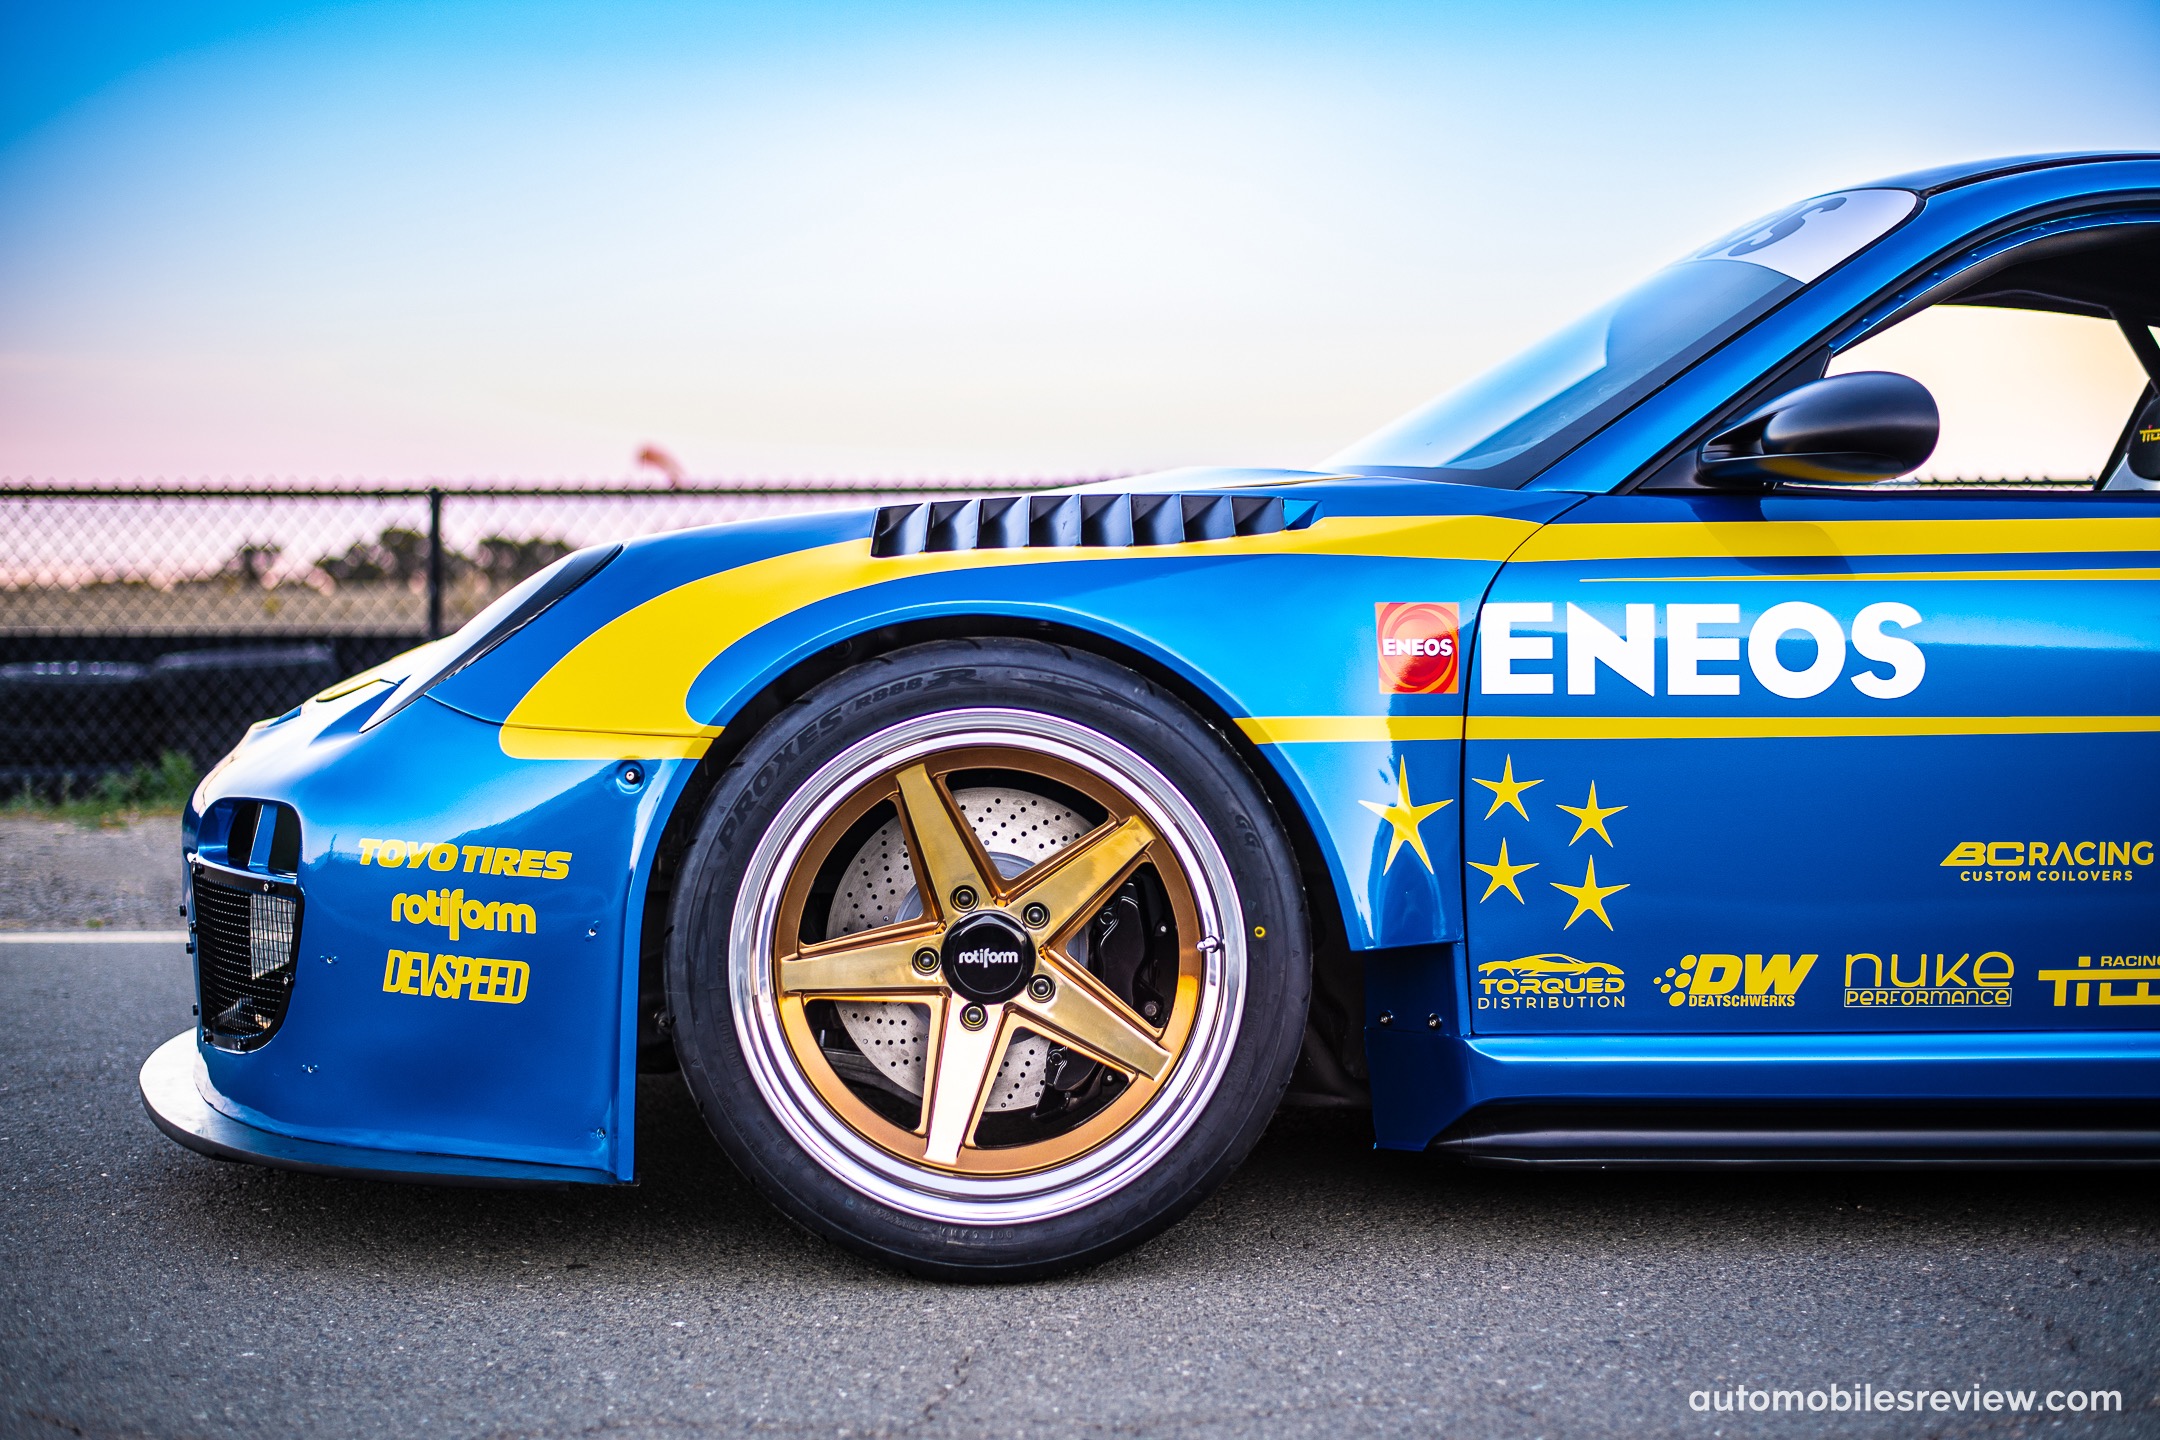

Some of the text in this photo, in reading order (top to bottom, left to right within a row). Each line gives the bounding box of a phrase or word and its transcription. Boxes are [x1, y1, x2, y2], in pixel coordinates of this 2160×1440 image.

[1382, 638, 1453, 657] ENEOS
[1480, 601, 1926, 699] ENEOS
[718, 706, 844, 848] PROXES
[358, 837, 573, 880] TOYO TIRES
[2028, 841, 2155, 866] RACING
[1960, 870, 2133, 882] CUSTOM COILOVERS
[391, 888, 537, 941] rotiform
[958, 948, 1018, 968] rotiform
[2100, 955, 2160, 967] RACIN
[382, 949, 531, 1005] DEVSPEED
[1690, 953, 1819, 995] DW
[1479, 977, 1625, 995] TORQUED
[1478, 996, 1625, 1010] DISTRIBUTION
[1688, 994, 1796, 1007] DEATSCHWERKS
